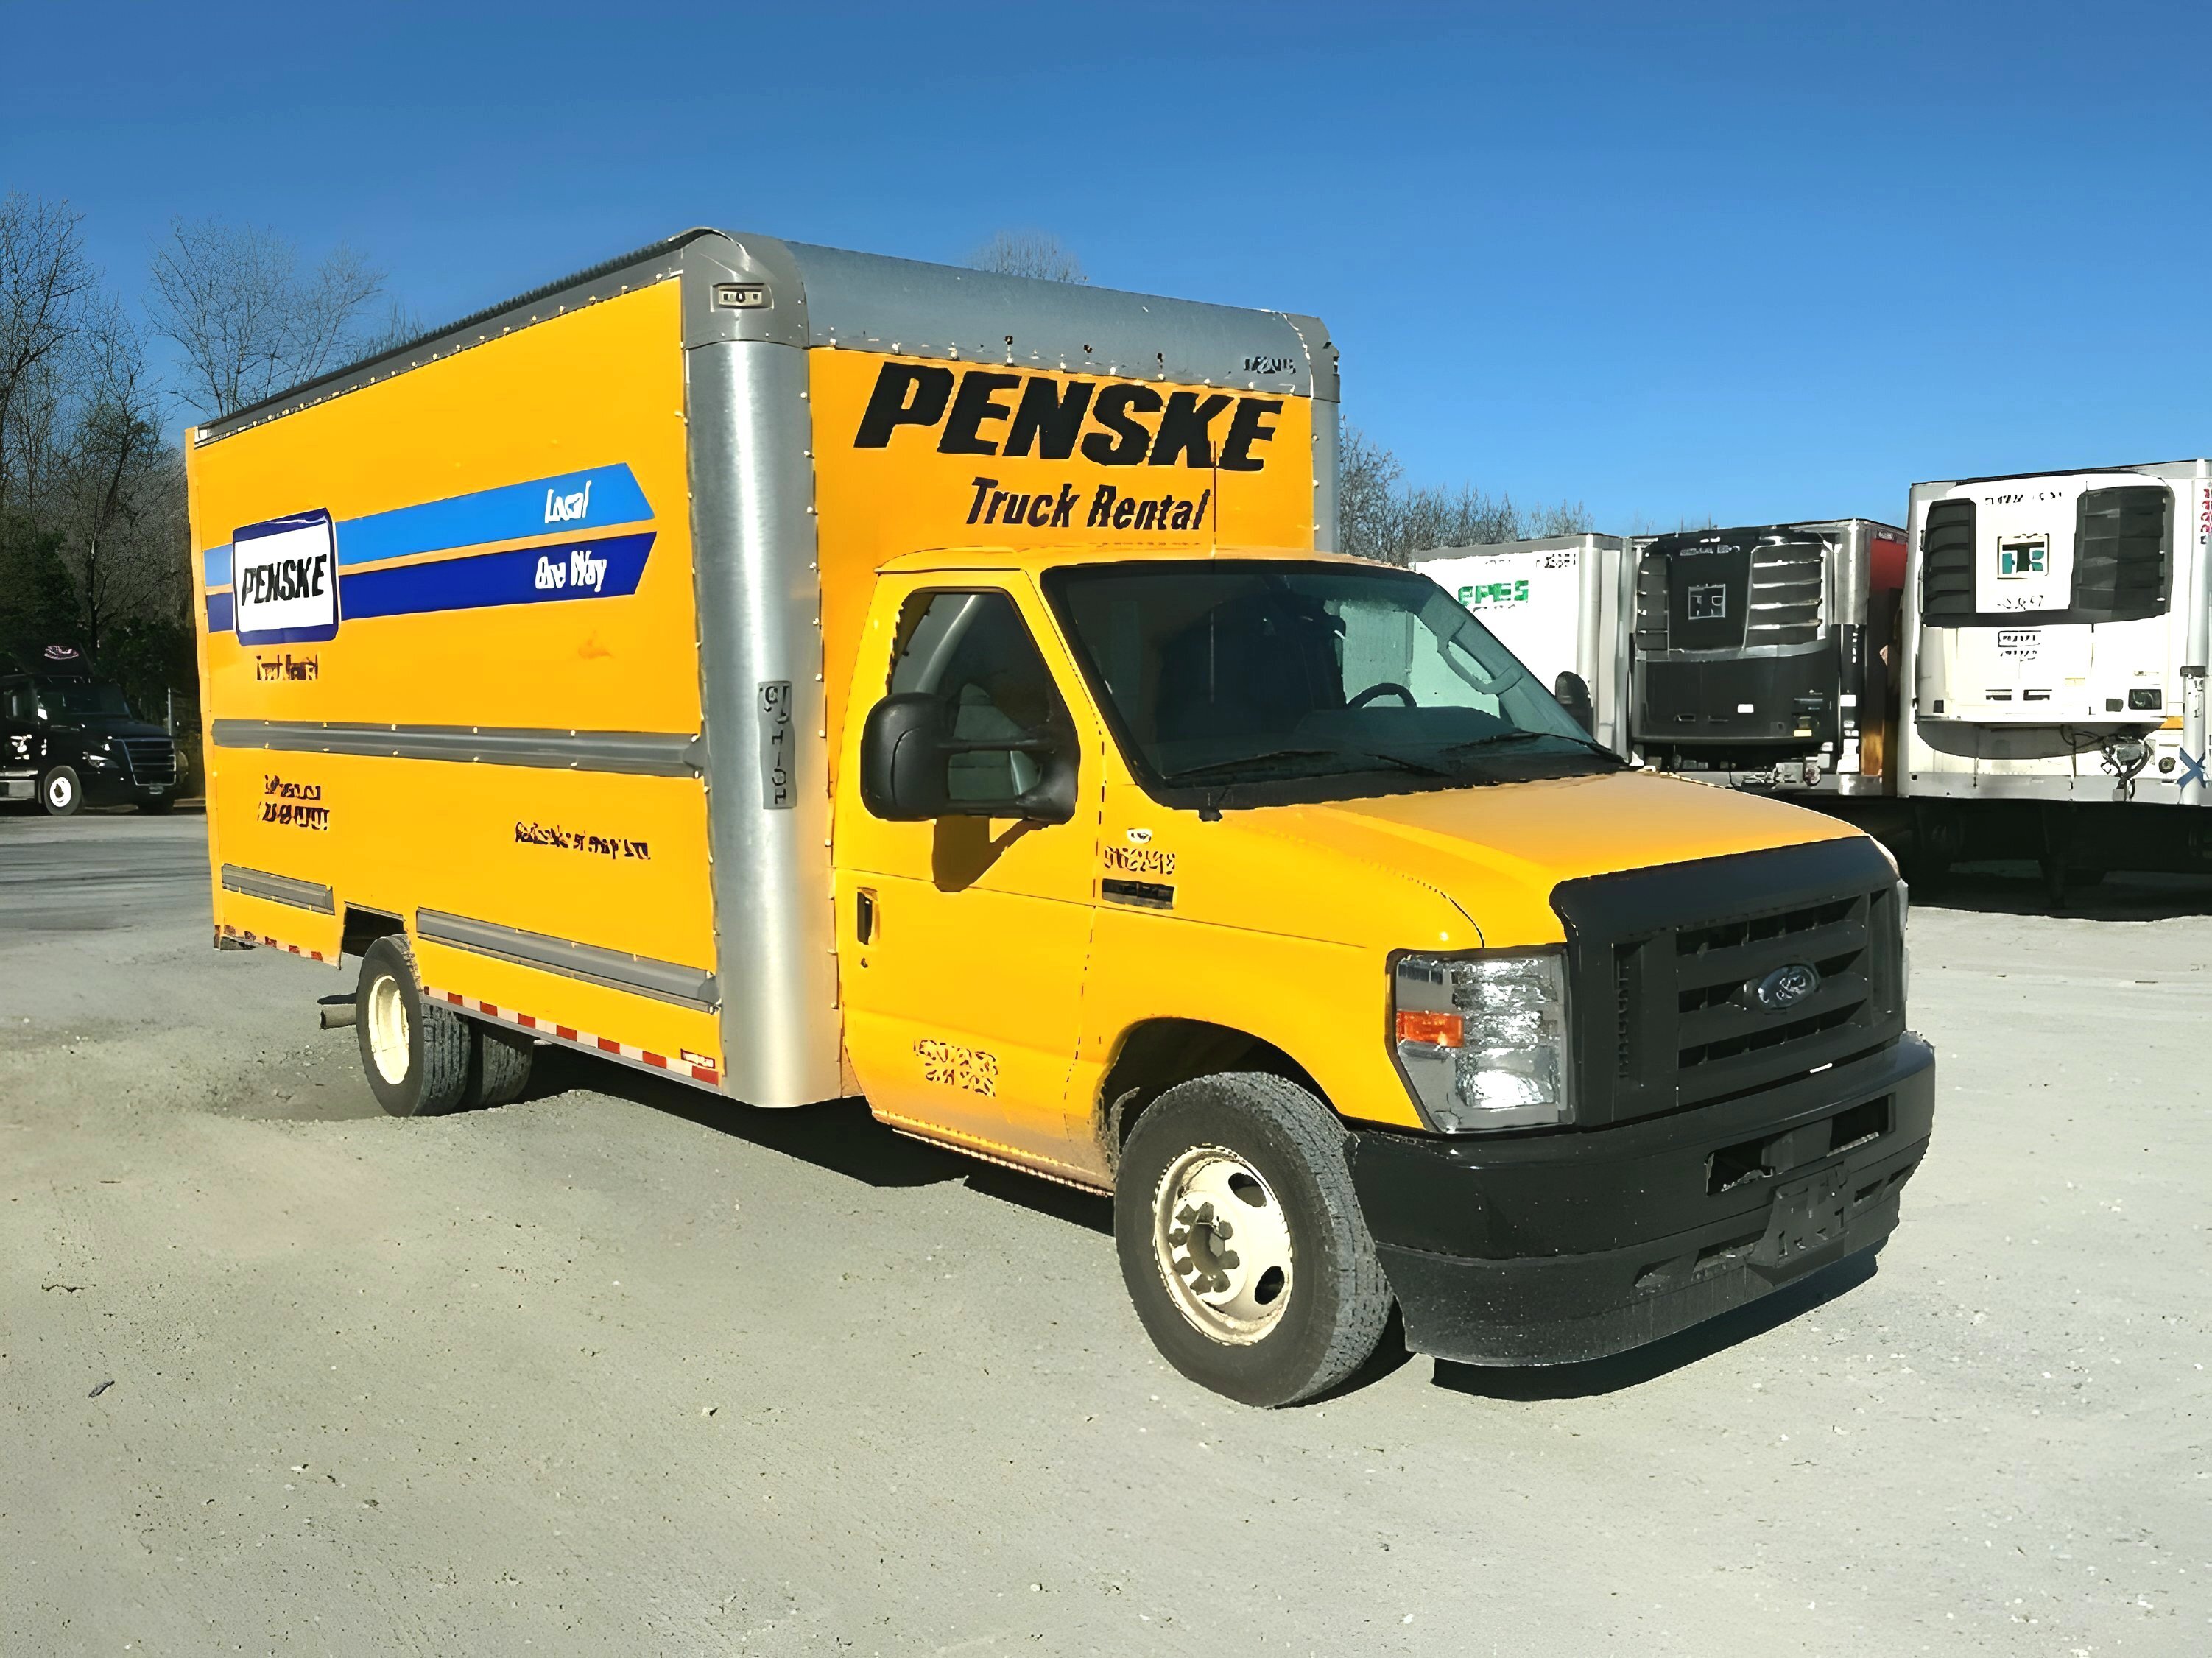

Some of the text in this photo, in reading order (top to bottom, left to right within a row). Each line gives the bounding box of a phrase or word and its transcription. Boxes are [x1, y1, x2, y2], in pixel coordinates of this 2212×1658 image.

[854, 362, 1283, 471] PENSKE
[544, 480, 592, 524] Local
[966, 477, 1211, 530] Truck Rental
[241, 553, 327, 607] PENSKE
